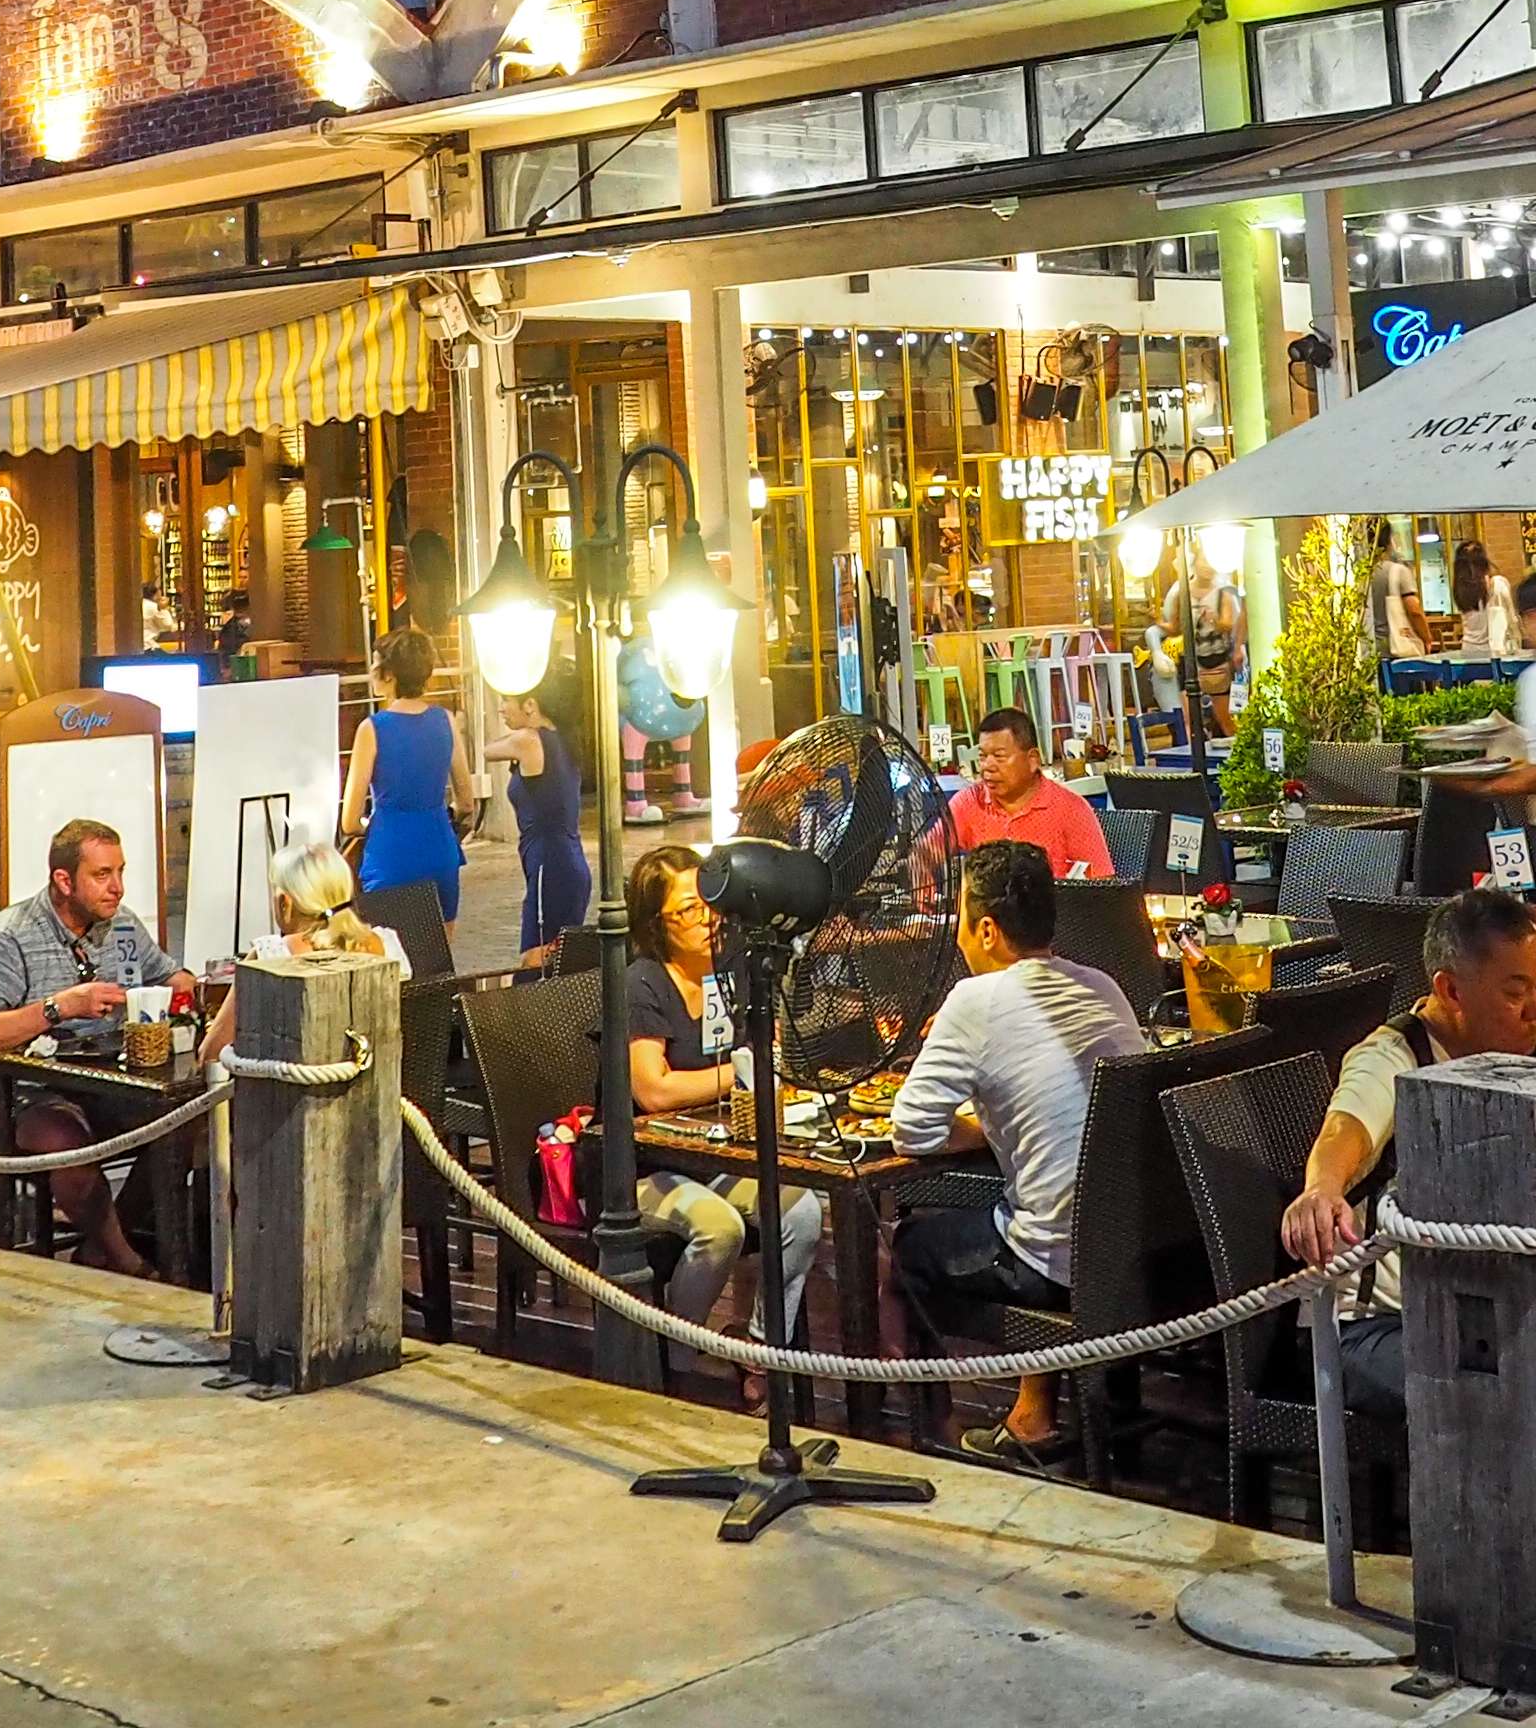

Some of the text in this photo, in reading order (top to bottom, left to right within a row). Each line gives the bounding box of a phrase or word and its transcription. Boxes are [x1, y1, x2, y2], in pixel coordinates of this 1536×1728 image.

[1409, 410, 1513, 440] MOËT
[1503, 414, 1527, 433] &
[999, 454, 1113, 500] HAPPY
[1023, 497, 1104, 542] FISH
[931, 732, 950, 747] 26
[1265, 737, 1282, 754] 56
[1170, 834, 1200, 851] 52/3
[1493, 841, 1526, 867] 53
[116, 938, 139, 963] 52
